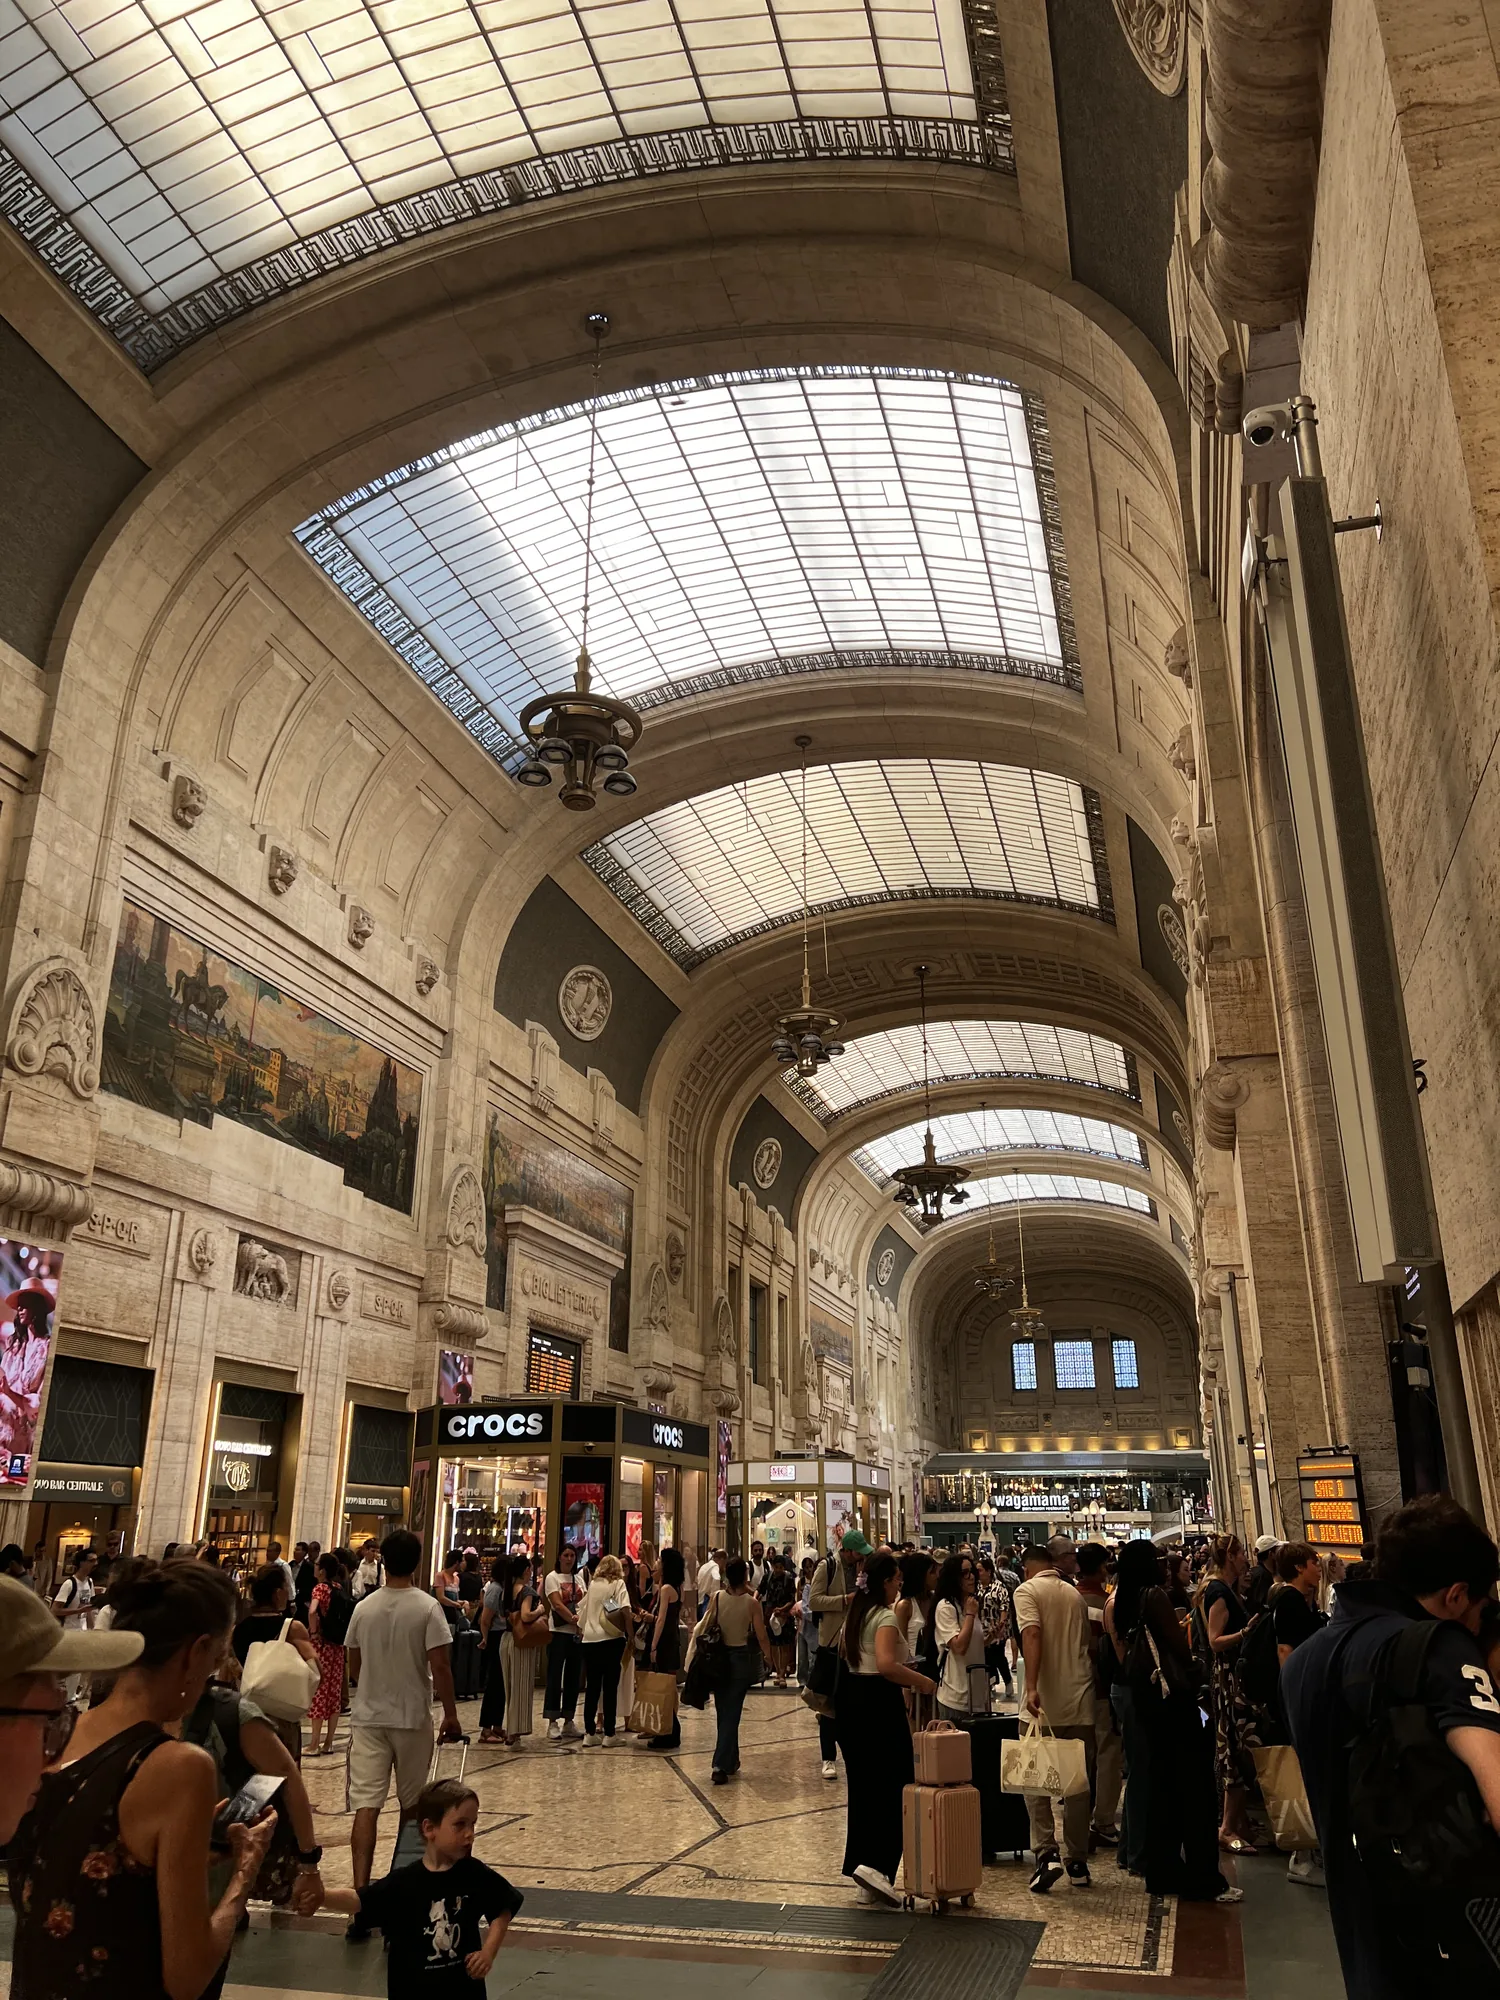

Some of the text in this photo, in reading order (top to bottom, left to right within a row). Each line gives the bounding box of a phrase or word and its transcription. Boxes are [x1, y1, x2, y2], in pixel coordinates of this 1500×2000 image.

[531, 1274, 593, 1317] BIGLIETTERIA
[447, 1413, 543, 1438] crocs
[652, 1422, 683, 1449] crocs
[50, 1480, 65, 1490] BAR
[66, 1481, 104, 1492] CENTRALE
[994, 1494, 1070, 1510] wagamama
[1461, 1664, 1500, 1714] 3
